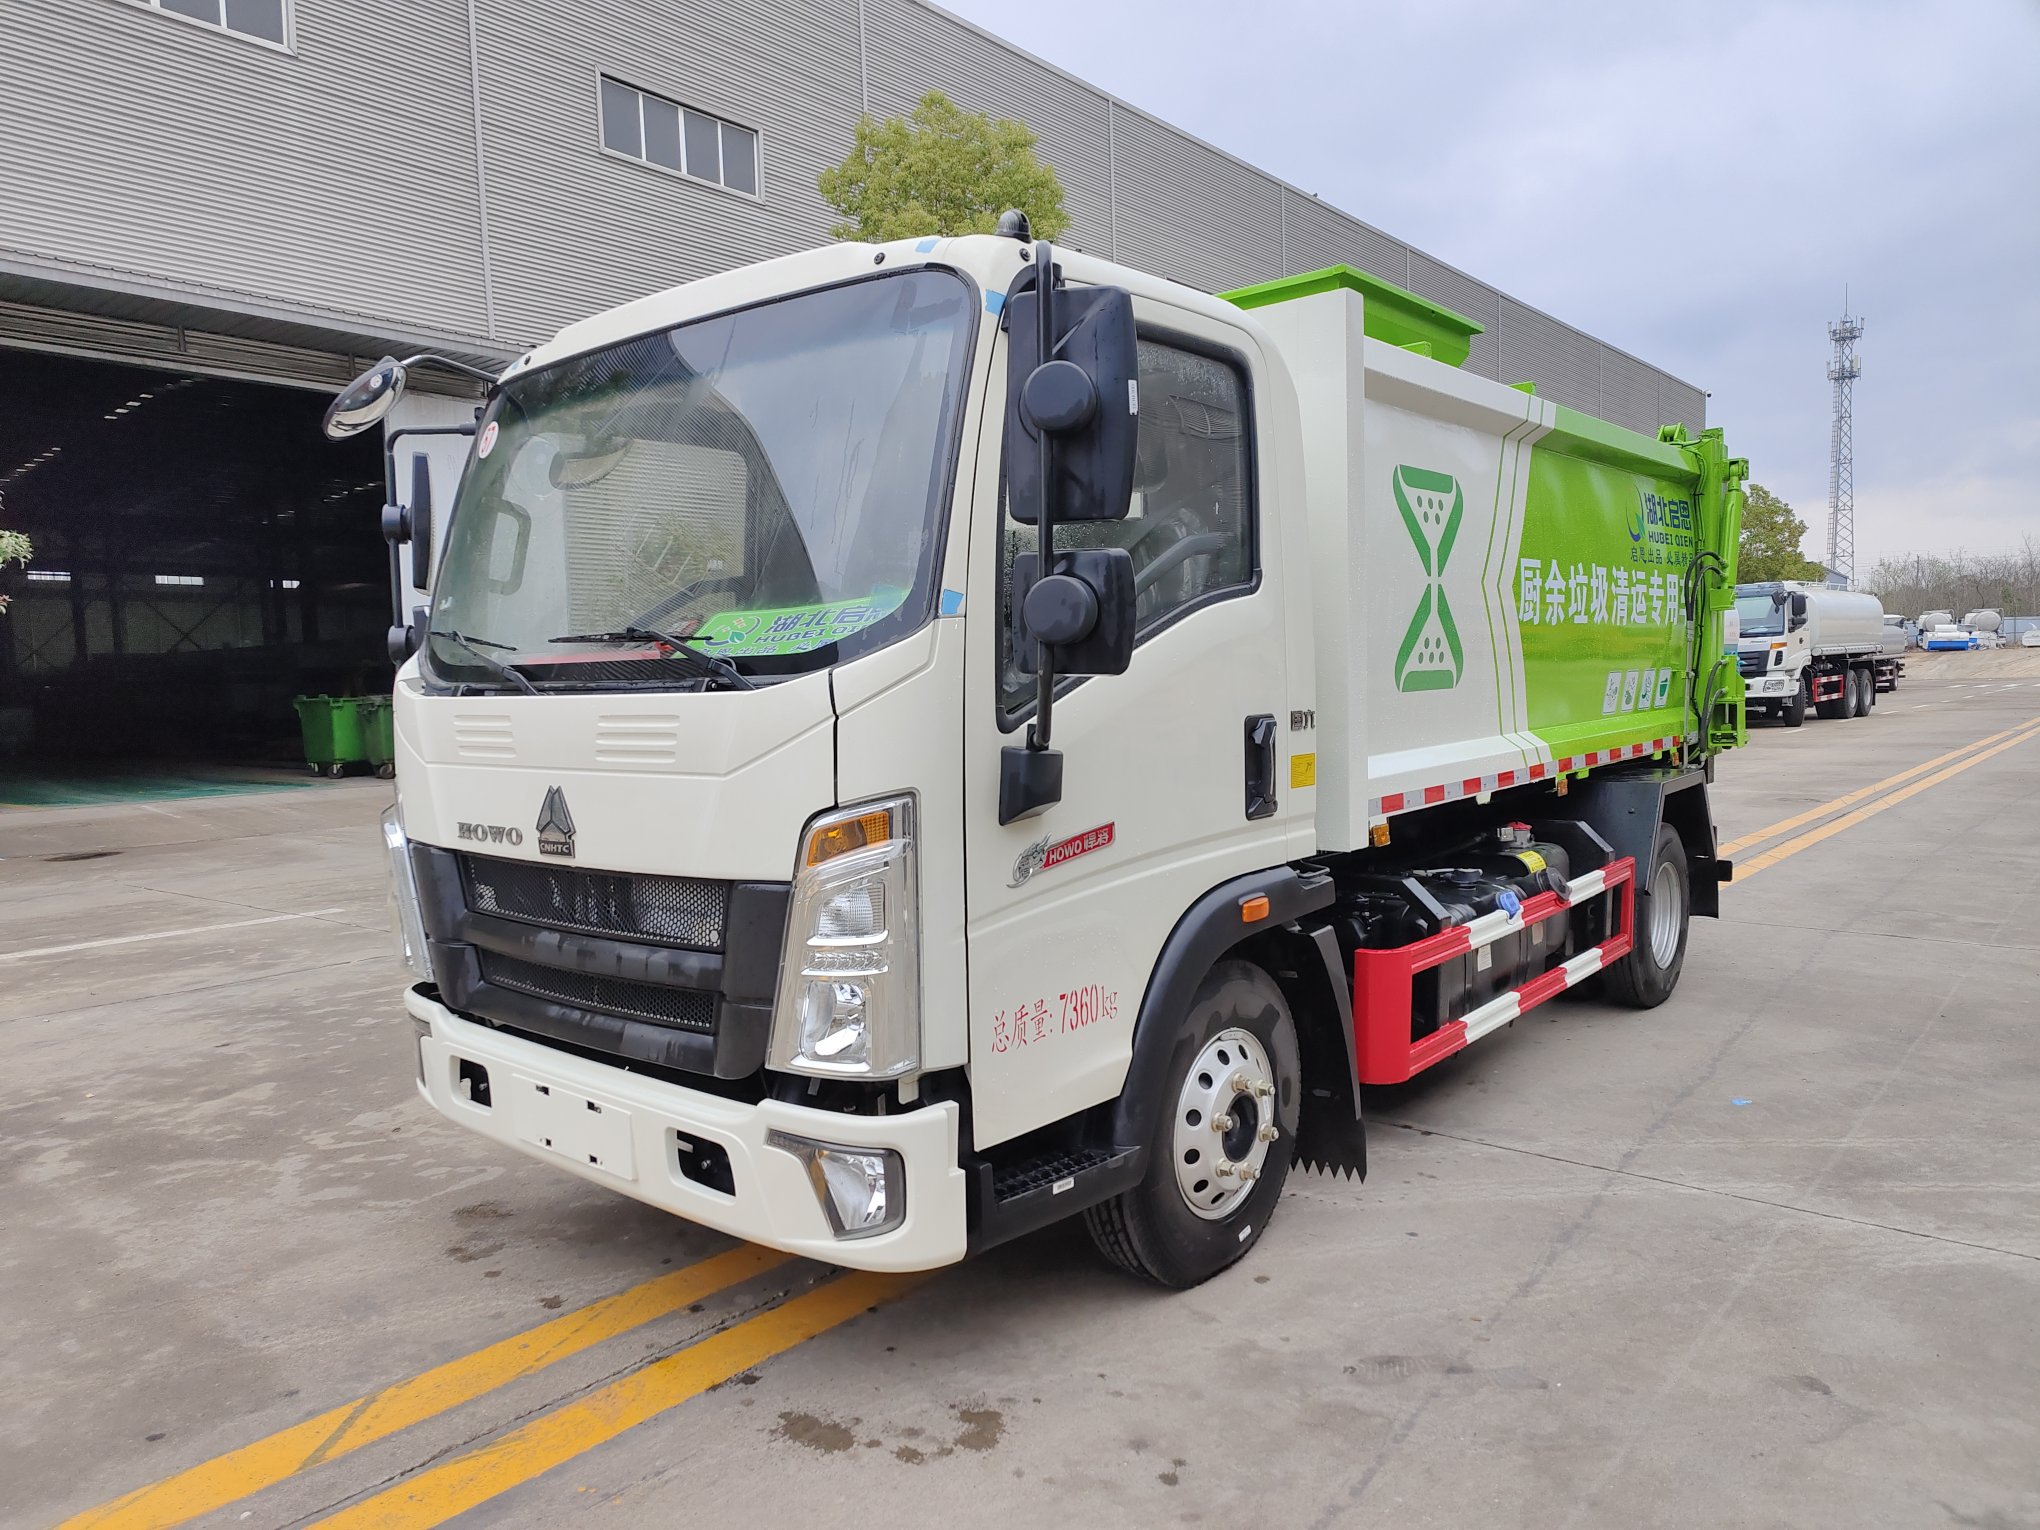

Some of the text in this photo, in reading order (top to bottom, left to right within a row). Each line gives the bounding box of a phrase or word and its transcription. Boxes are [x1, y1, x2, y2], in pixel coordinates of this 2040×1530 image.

[1644, 492, 1692, 531] 湖北启恩
[1648, 531, 1694, 548] HUBEI QIEN
[753, 629, 826, 645] HUBEI
[457, 822, 523, 846] HOWO
[540, 842, 570, 853] CNHTC
[1049, 841, 1083, 864] HOWO
